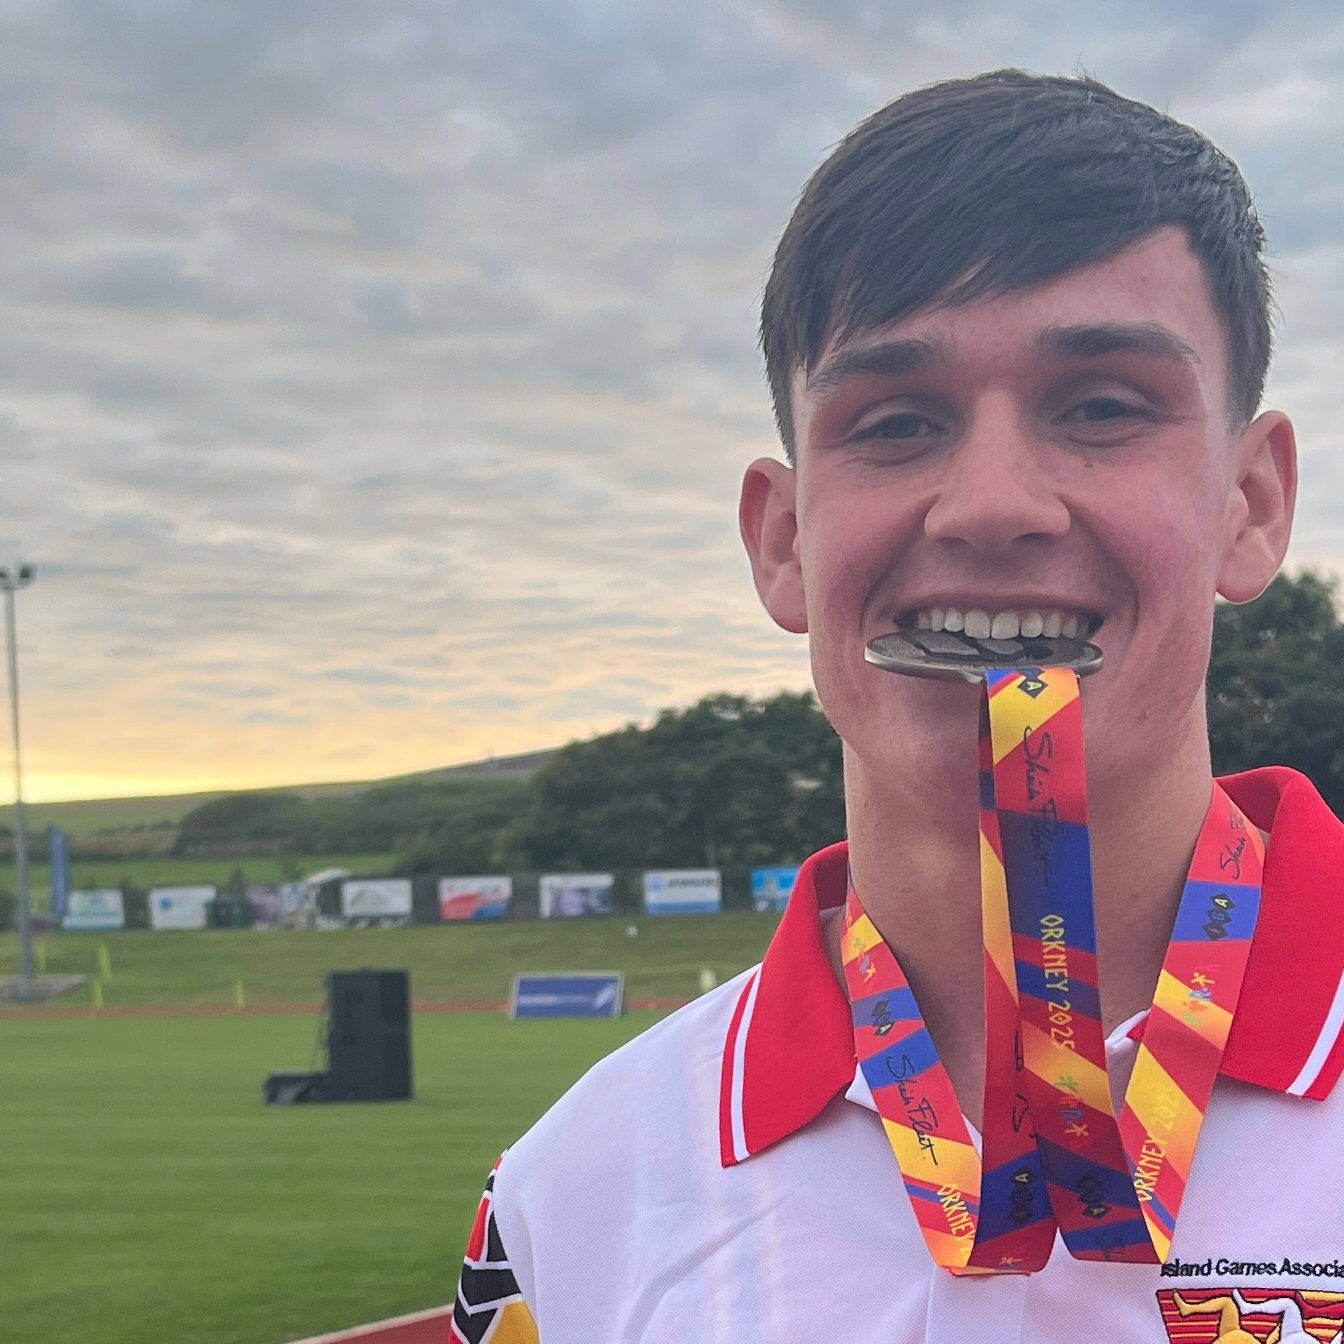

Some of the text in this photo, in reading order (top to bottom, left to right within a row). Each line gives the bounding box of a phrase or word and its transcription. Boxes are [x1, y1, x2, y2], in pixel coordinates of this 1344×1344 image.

[1040, 914, 1069, 992] ORKNEY
[936, 1183, 976, 1242] ORKNEY
[1216, 1259, 1276, 1277] Games
